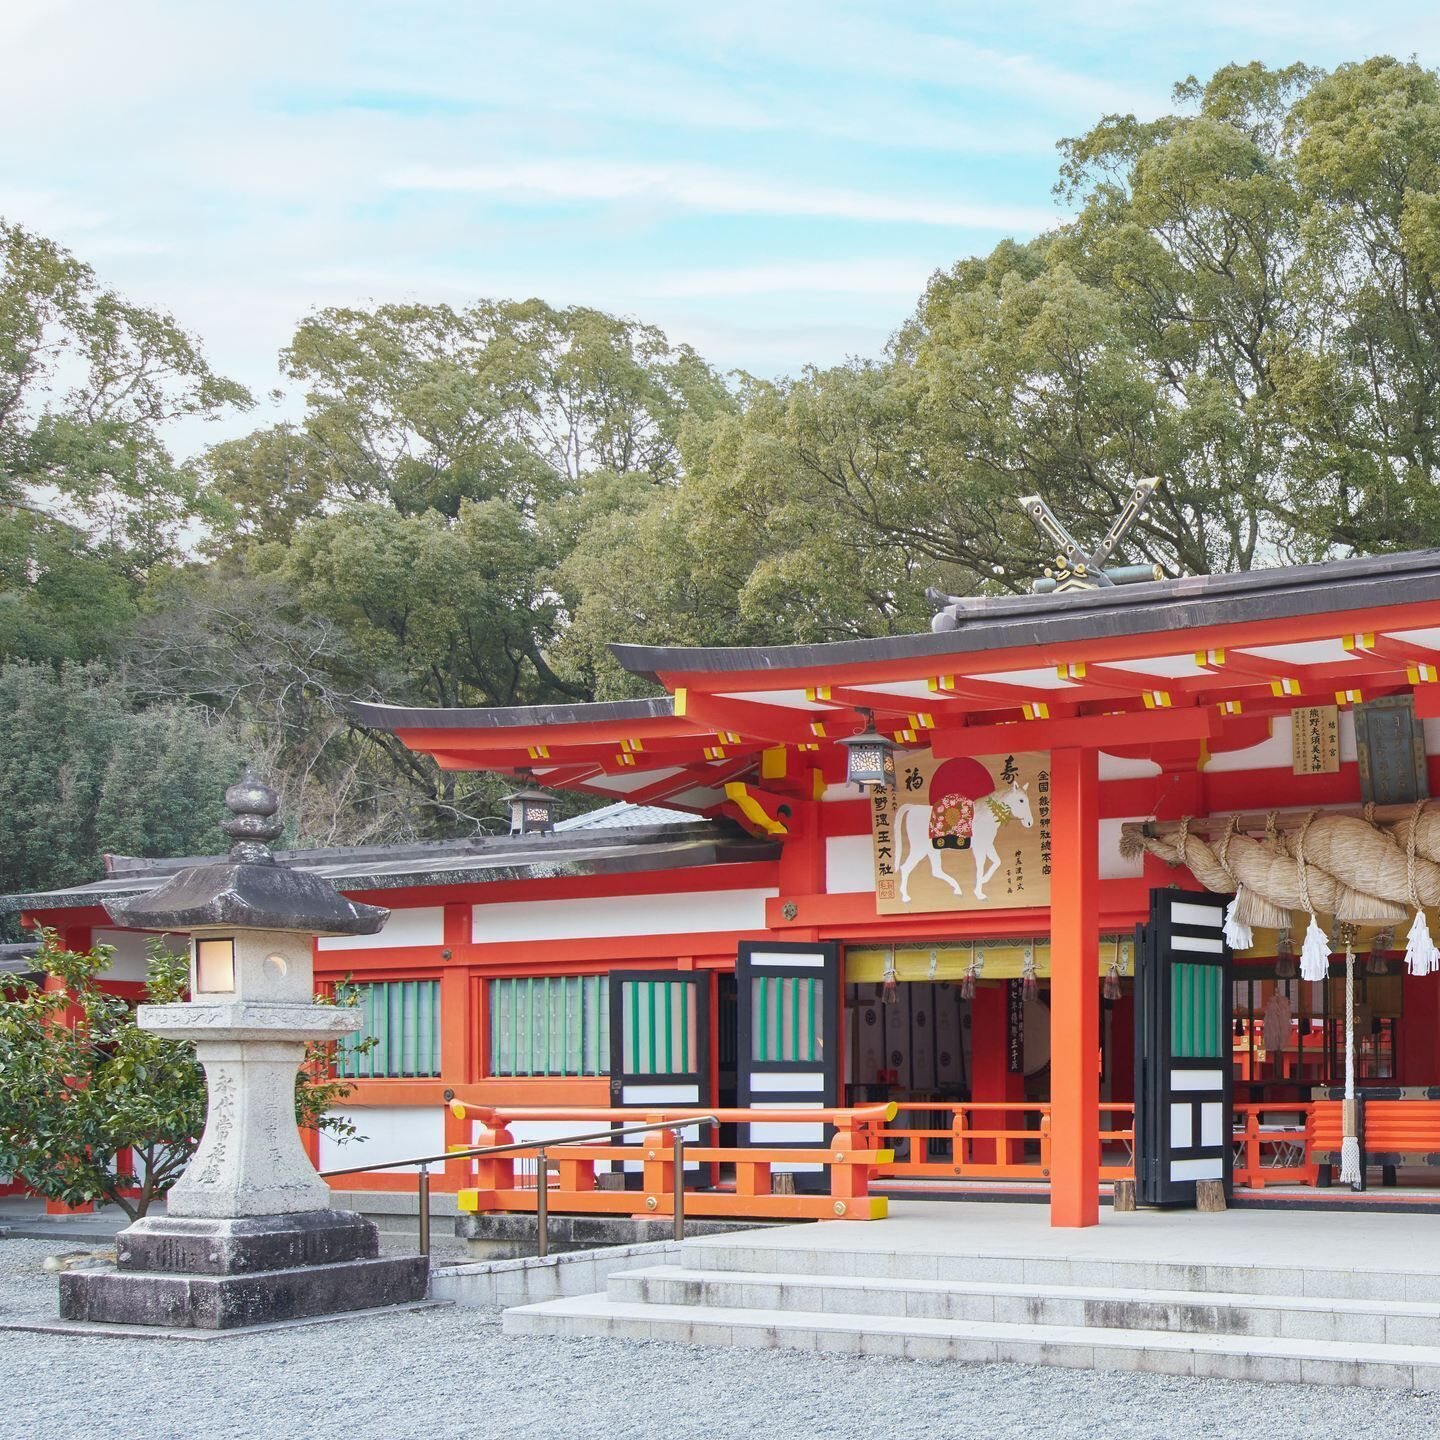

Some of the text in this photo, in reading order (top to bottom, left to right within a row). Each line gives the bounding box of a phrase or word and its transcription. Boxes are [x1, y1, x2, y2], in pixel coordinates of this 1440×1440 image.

[1309, 708, 1322, 772] 熊野夫須美大神
[905, 767, 924, 792] 福
